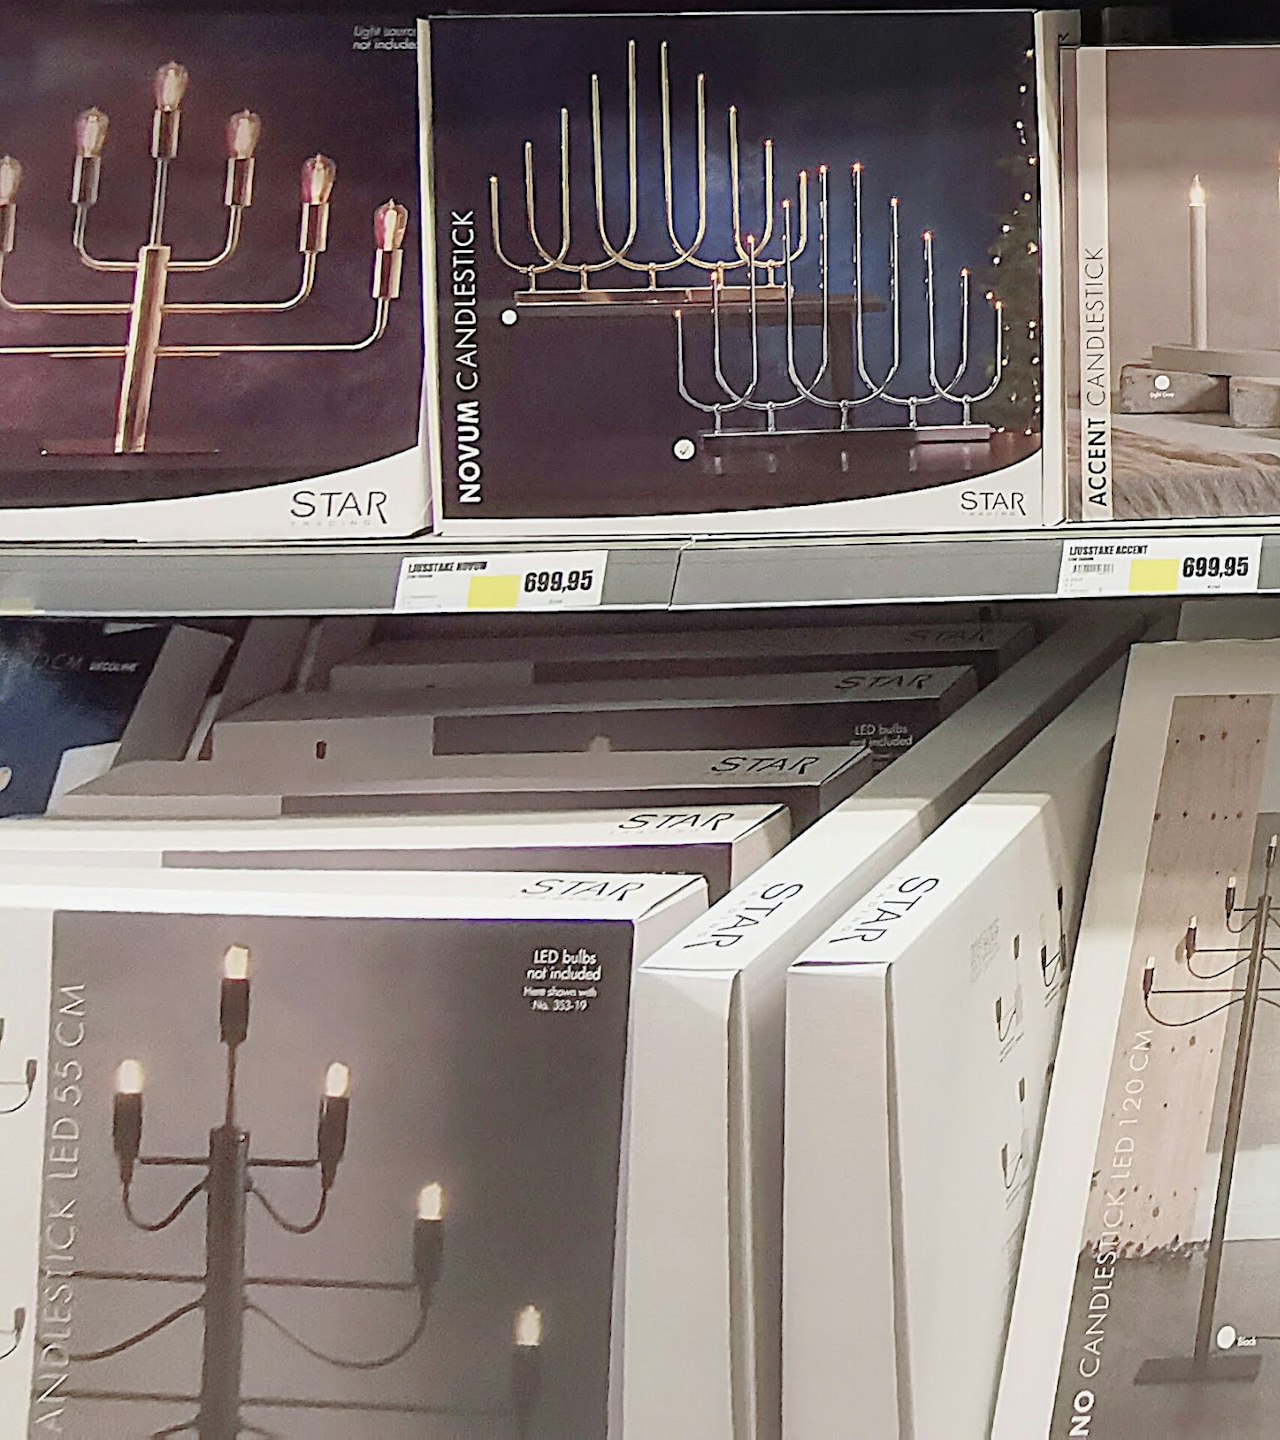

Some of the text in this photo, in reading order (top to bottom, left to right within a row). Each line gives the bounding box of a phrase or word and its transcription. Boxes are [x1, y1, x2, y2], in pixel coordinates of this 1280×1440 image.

[374, 38, 417, 50] include
[451, 210, 482, 504] NOVUM CANDLESTICK
[1085, 246, 1110, 506] ACCENT CANDLESTICK
[290, 491, 389, 524] STAR
[960, 491, 1026, 516] STAR
[1070, 545, 1148, 555] LJUSSTAKE ACCENT
[1183, 557, 1249, 578] 699,95
[524, 570, 593, 593] 699,95
[835, 674, 933, 689] STAR
[855, 724, 908, 735] LED bulbs
[711, 756, 821, 775] STAR
[618, 812, 735, 831] STAR
[521, 879, 645, 902] STAR
[683, 882, 804, 950] STAR
[829, 876, 938, 944] STAR
[533, 948, 597, 965] LED bulbs
[526, 965, 602, 981] not included
[547, 986, 577, 997] shown
[55, 984, 88, 1041] CM
[552, 1000, 588, 1011] 353-19
[53, 1049, 85, 1109] 55
[51, 1116, 81, 1175] LED
[1068, 1029, 1153, 1438] NO CANDLESTICK LED 120 CM
